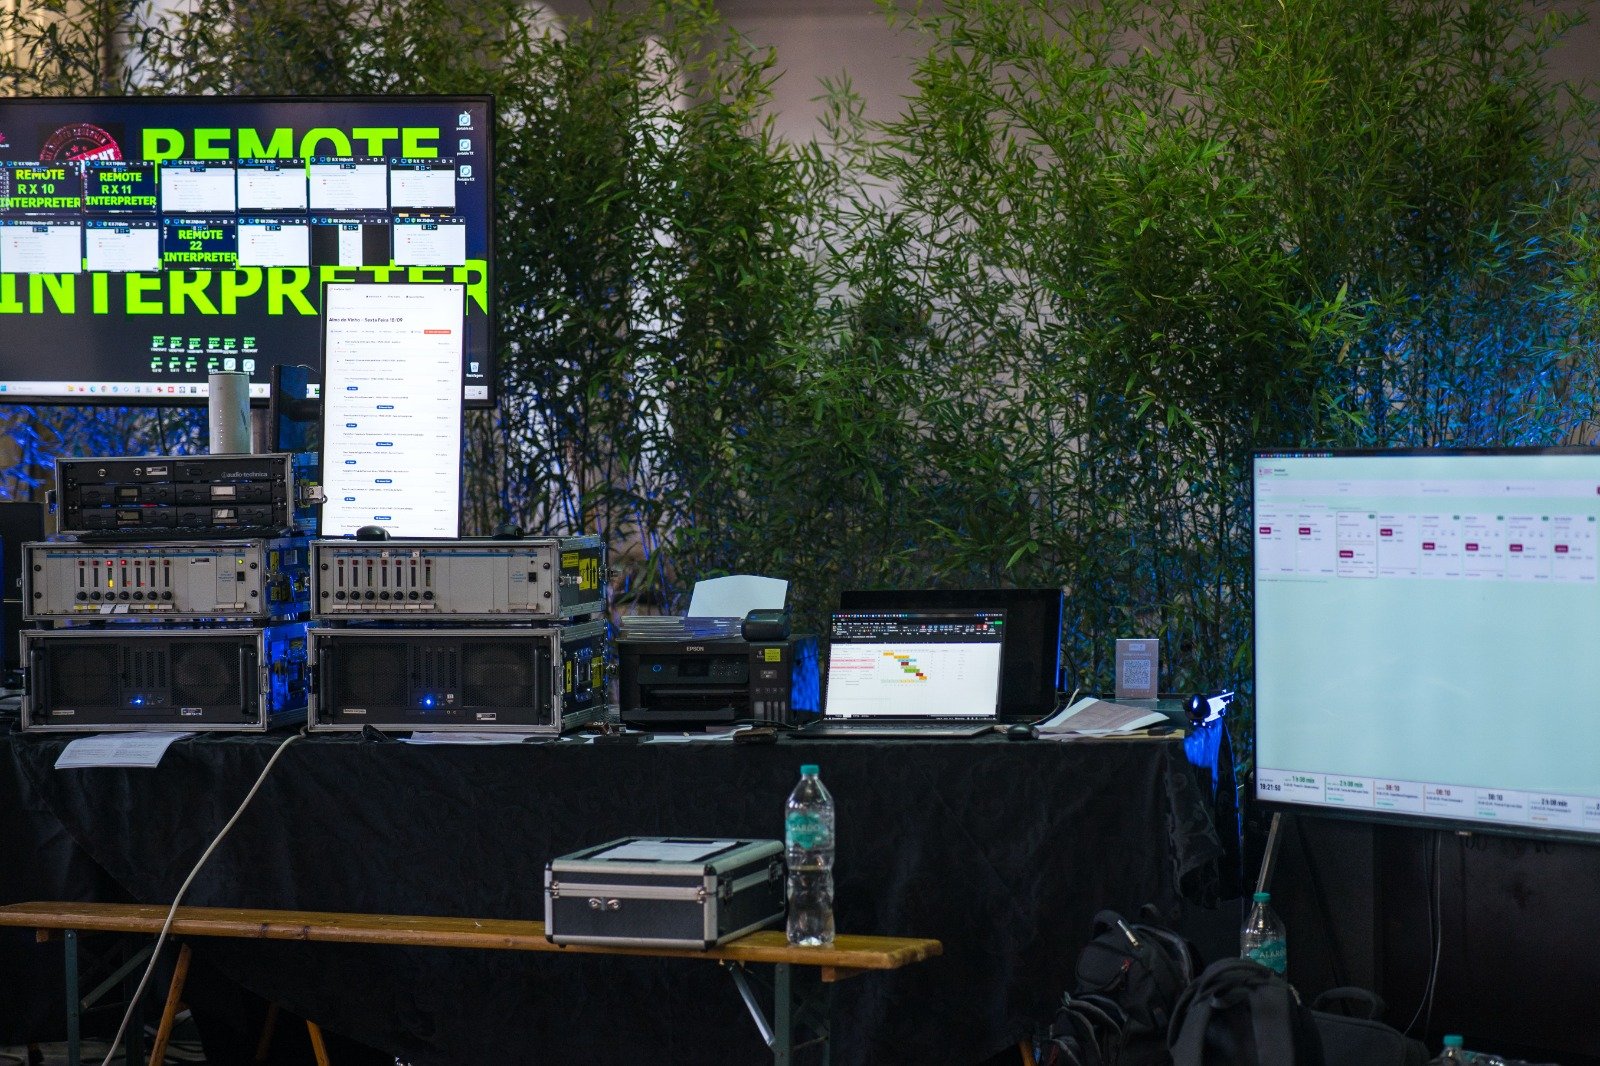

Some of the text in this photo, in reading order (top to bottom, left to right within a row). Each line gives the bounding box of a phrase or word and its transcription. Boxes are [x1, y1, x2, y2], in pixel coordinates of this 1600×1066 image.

[15, 168, 65, 181] REMOTE
[99, 172, 142, 182] REMOTE
[17, 183, 55, 195] R X 10
[101, 184, 131, 194] R X 11
[0, 197, 80, 208] INTERPRETER
[85, 195, 157, 206] INTERPRETER
[178, 229, 223, 240] REMOTE
[189, 241, 202, 251] 22
[164, 252, 237, 262] INTERPRETER
[0, 258, 488, 316] INTERPRR
